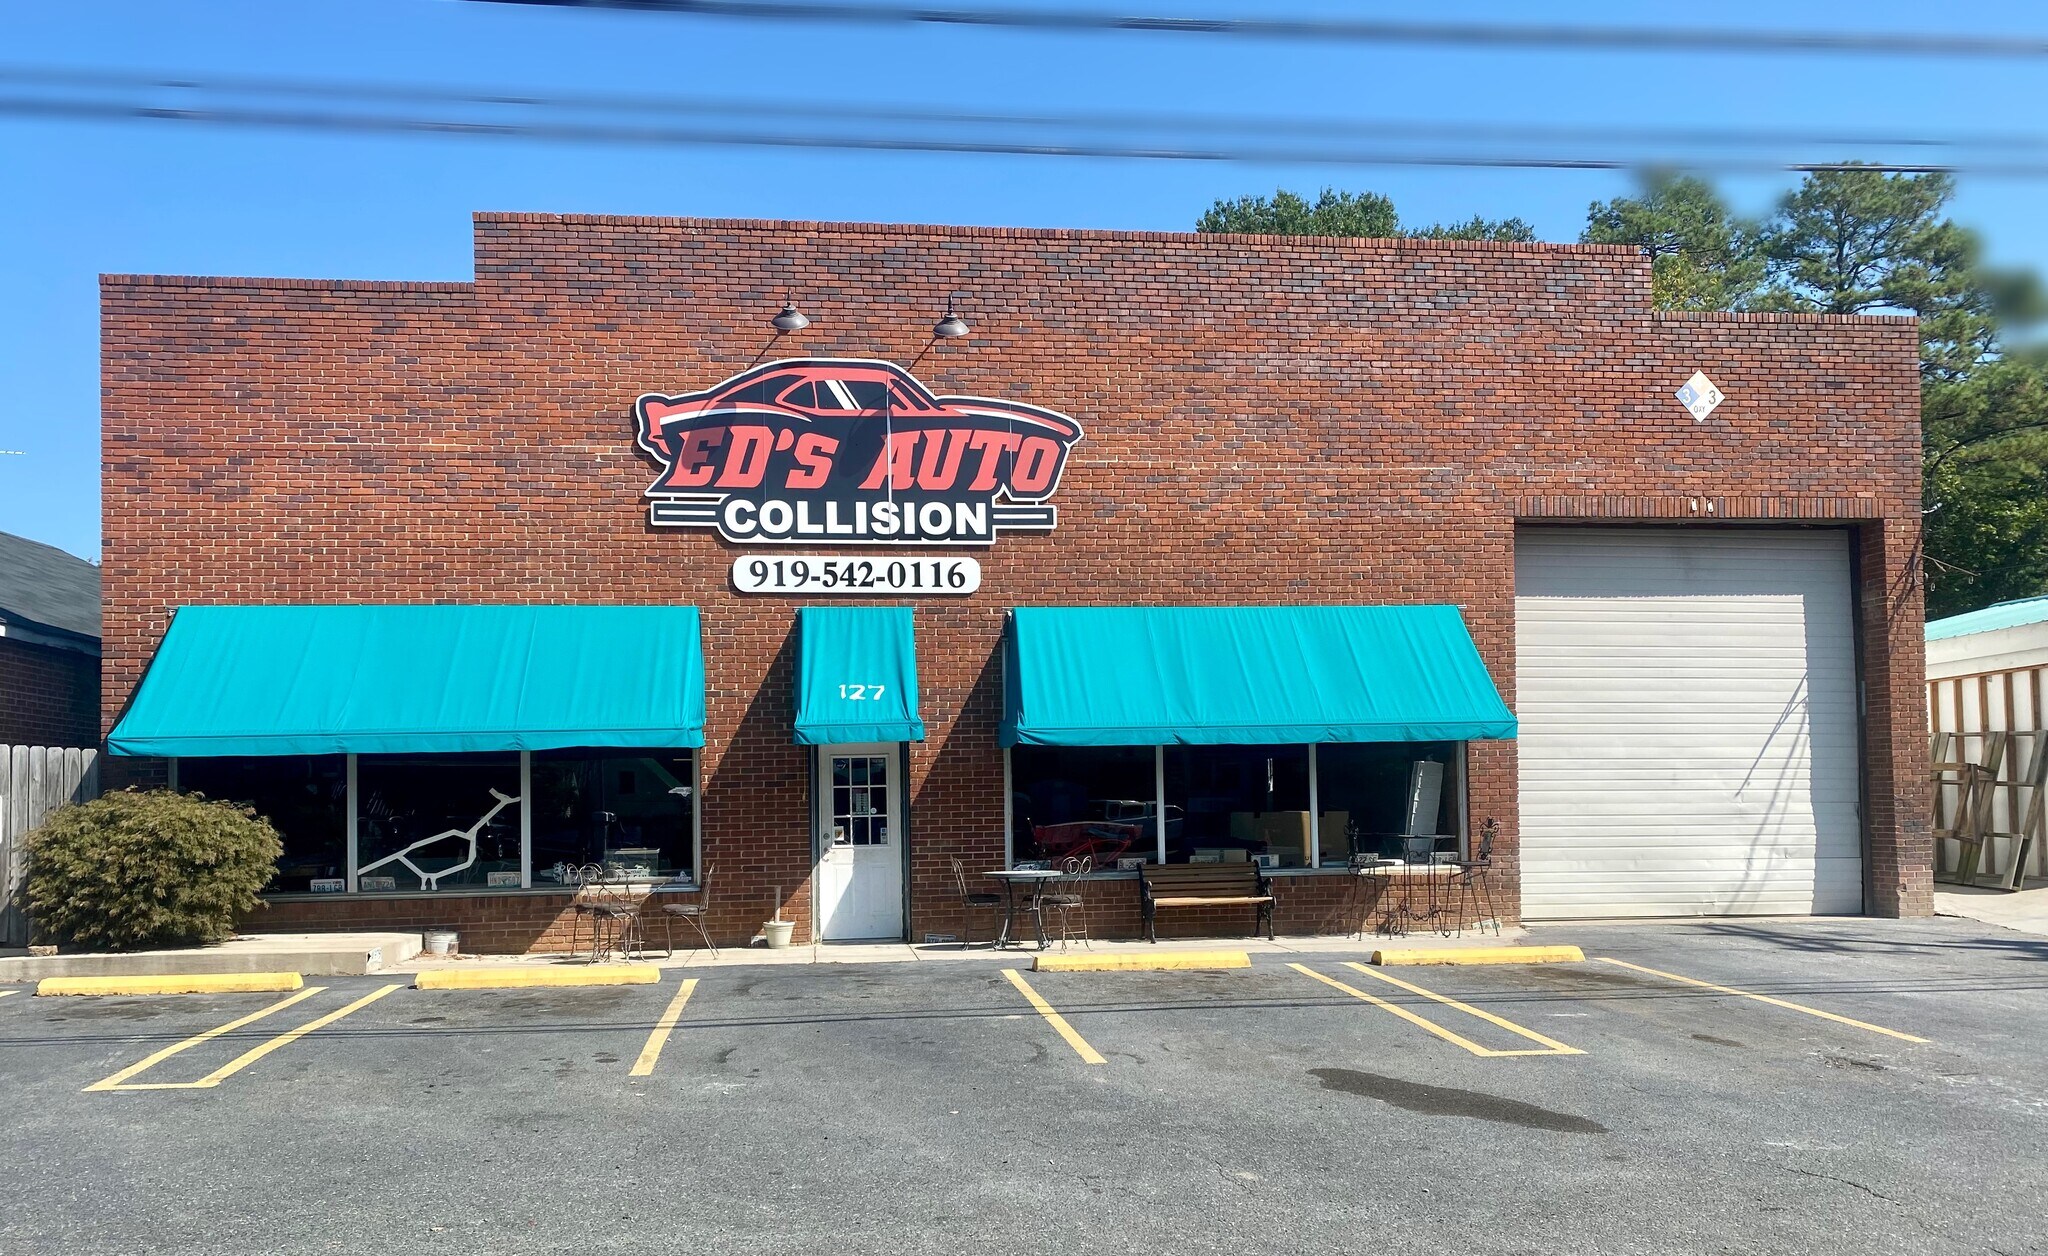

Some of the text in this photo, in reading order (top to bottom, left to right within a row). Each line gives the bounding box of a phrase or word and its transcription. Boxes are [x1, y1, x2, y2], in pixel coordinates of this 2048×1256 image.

[1682, 388, 1692, 404] 3
[1708, 390, 1717, 405] 3
[664, 425, 1062, 492] ED'S AUTO
[724, 499, 986, 536] COLLISION
[749, 560, 966, 588] 919-542-0116
[838, 684, 885, 701] 127
